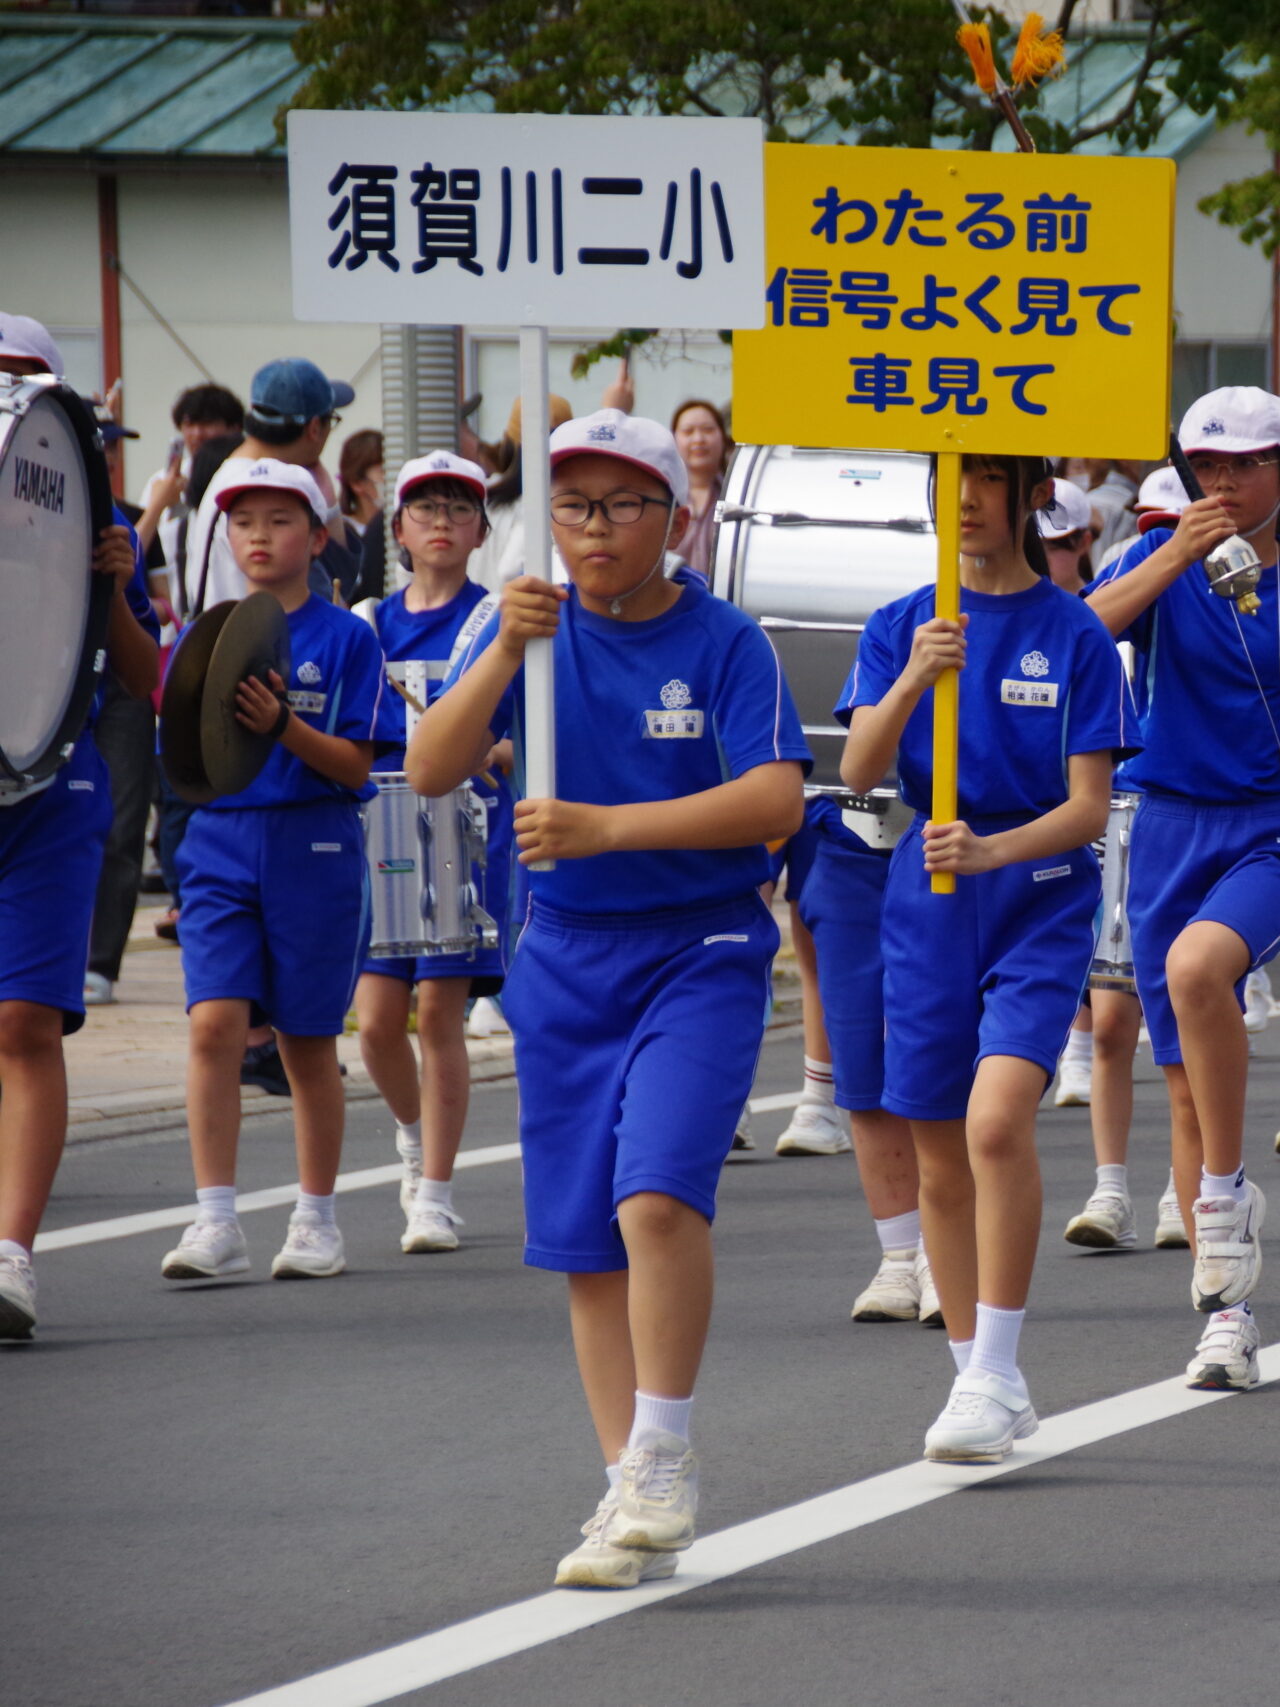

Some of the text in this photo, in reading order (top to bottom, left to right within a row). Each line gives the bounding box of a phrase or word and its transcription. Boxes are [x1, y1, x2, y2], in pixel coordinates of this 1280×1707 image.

[327, 161, 734, 279] 須賀川二小
[811, 186, 1092, 254] わたる前
[766, 266, 1141, 336] 信号よく見て
[846, 352, 1055, 416] 車見て
[14, 455, 65, 515] YAMAHA
